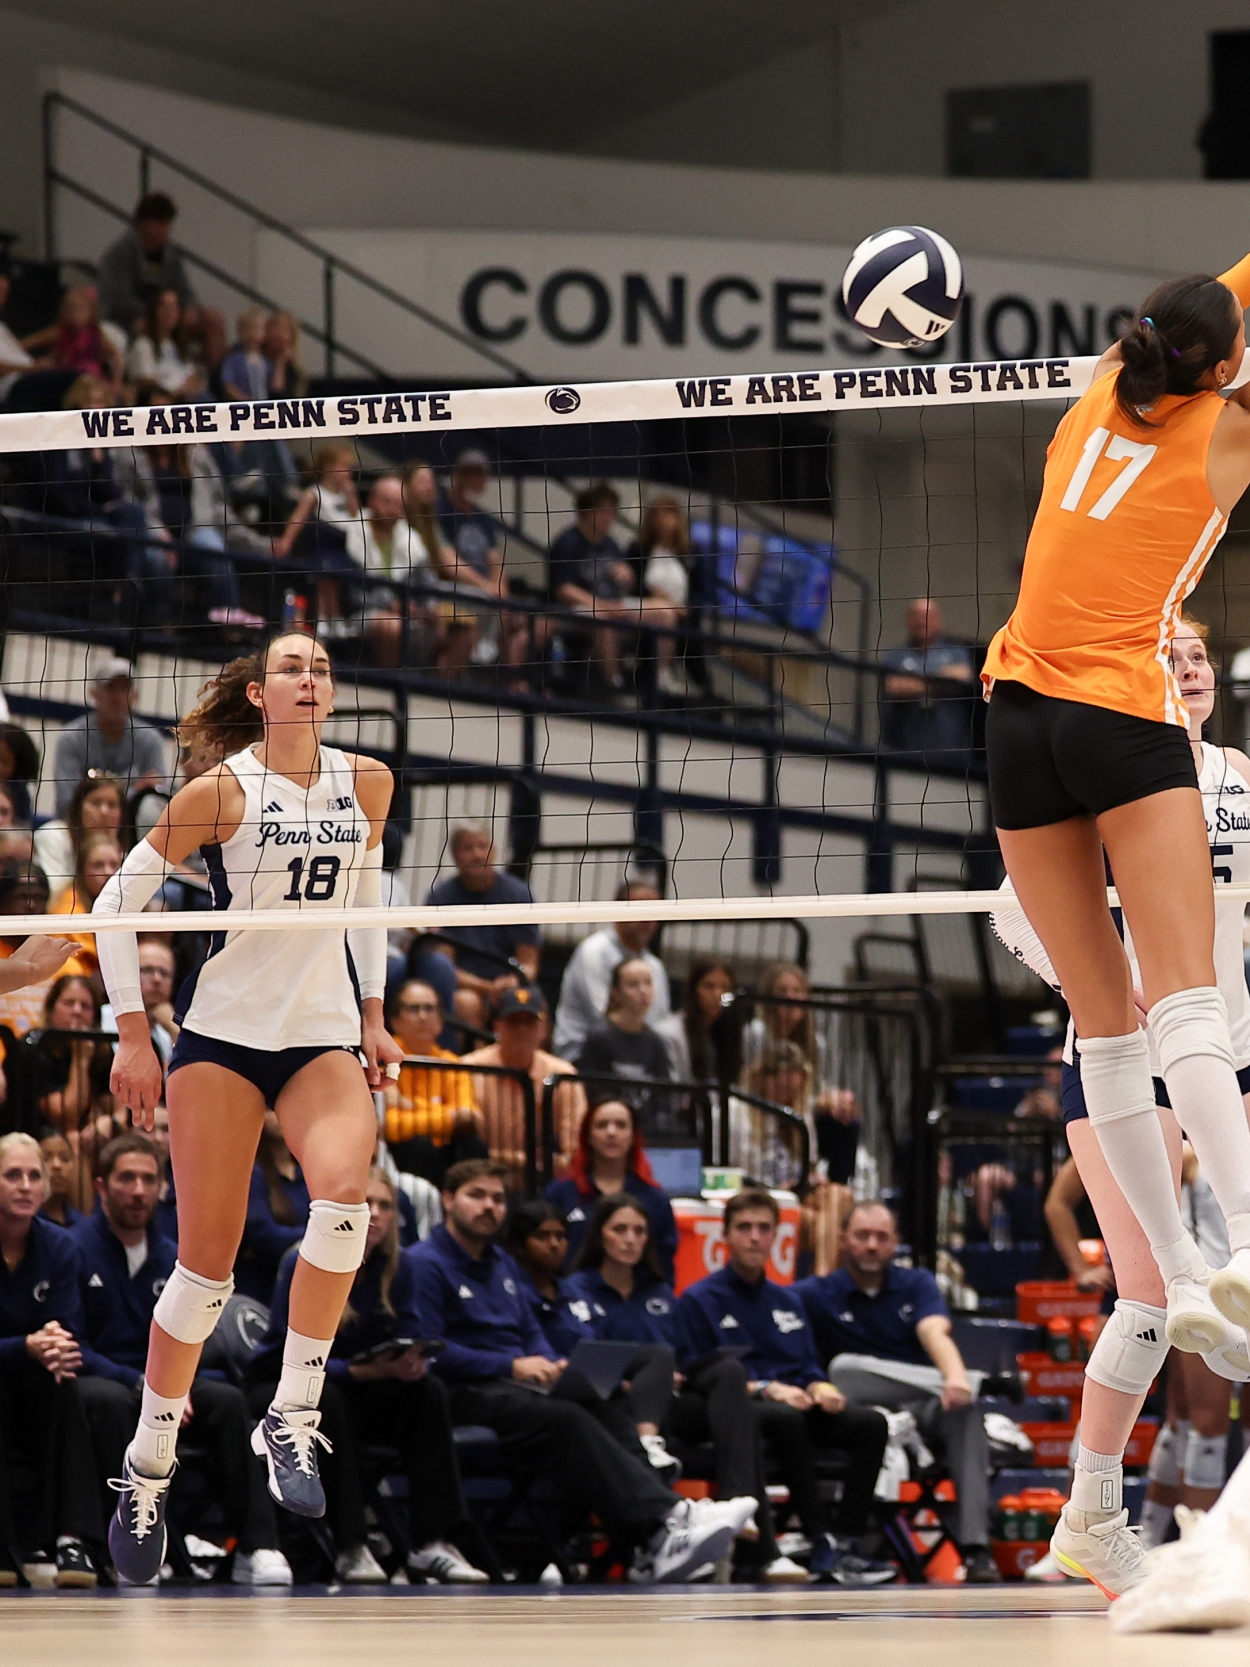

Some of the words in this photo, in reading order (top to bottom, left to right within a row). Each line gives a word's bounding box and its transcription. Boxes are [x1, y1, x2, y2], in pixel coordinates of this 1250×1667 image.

[675, 378, 734, 408] WE
[745, 373, 822, 405] ARE
[833, 367, 937, 399] PENN
[949, 360, 1071, 393] STATE
[81, 409, 135, 438] WE
[145, 405, 218, 435] ARE
[228, 400, 327, 431] PENN
[337, 393, 452, 426] STATE
[1060, 426, 1158, 521] 17
[255, 822, 312, 847] Penn
[317, 821, 362, 844] State
[283, 856, 341, 901] 18
